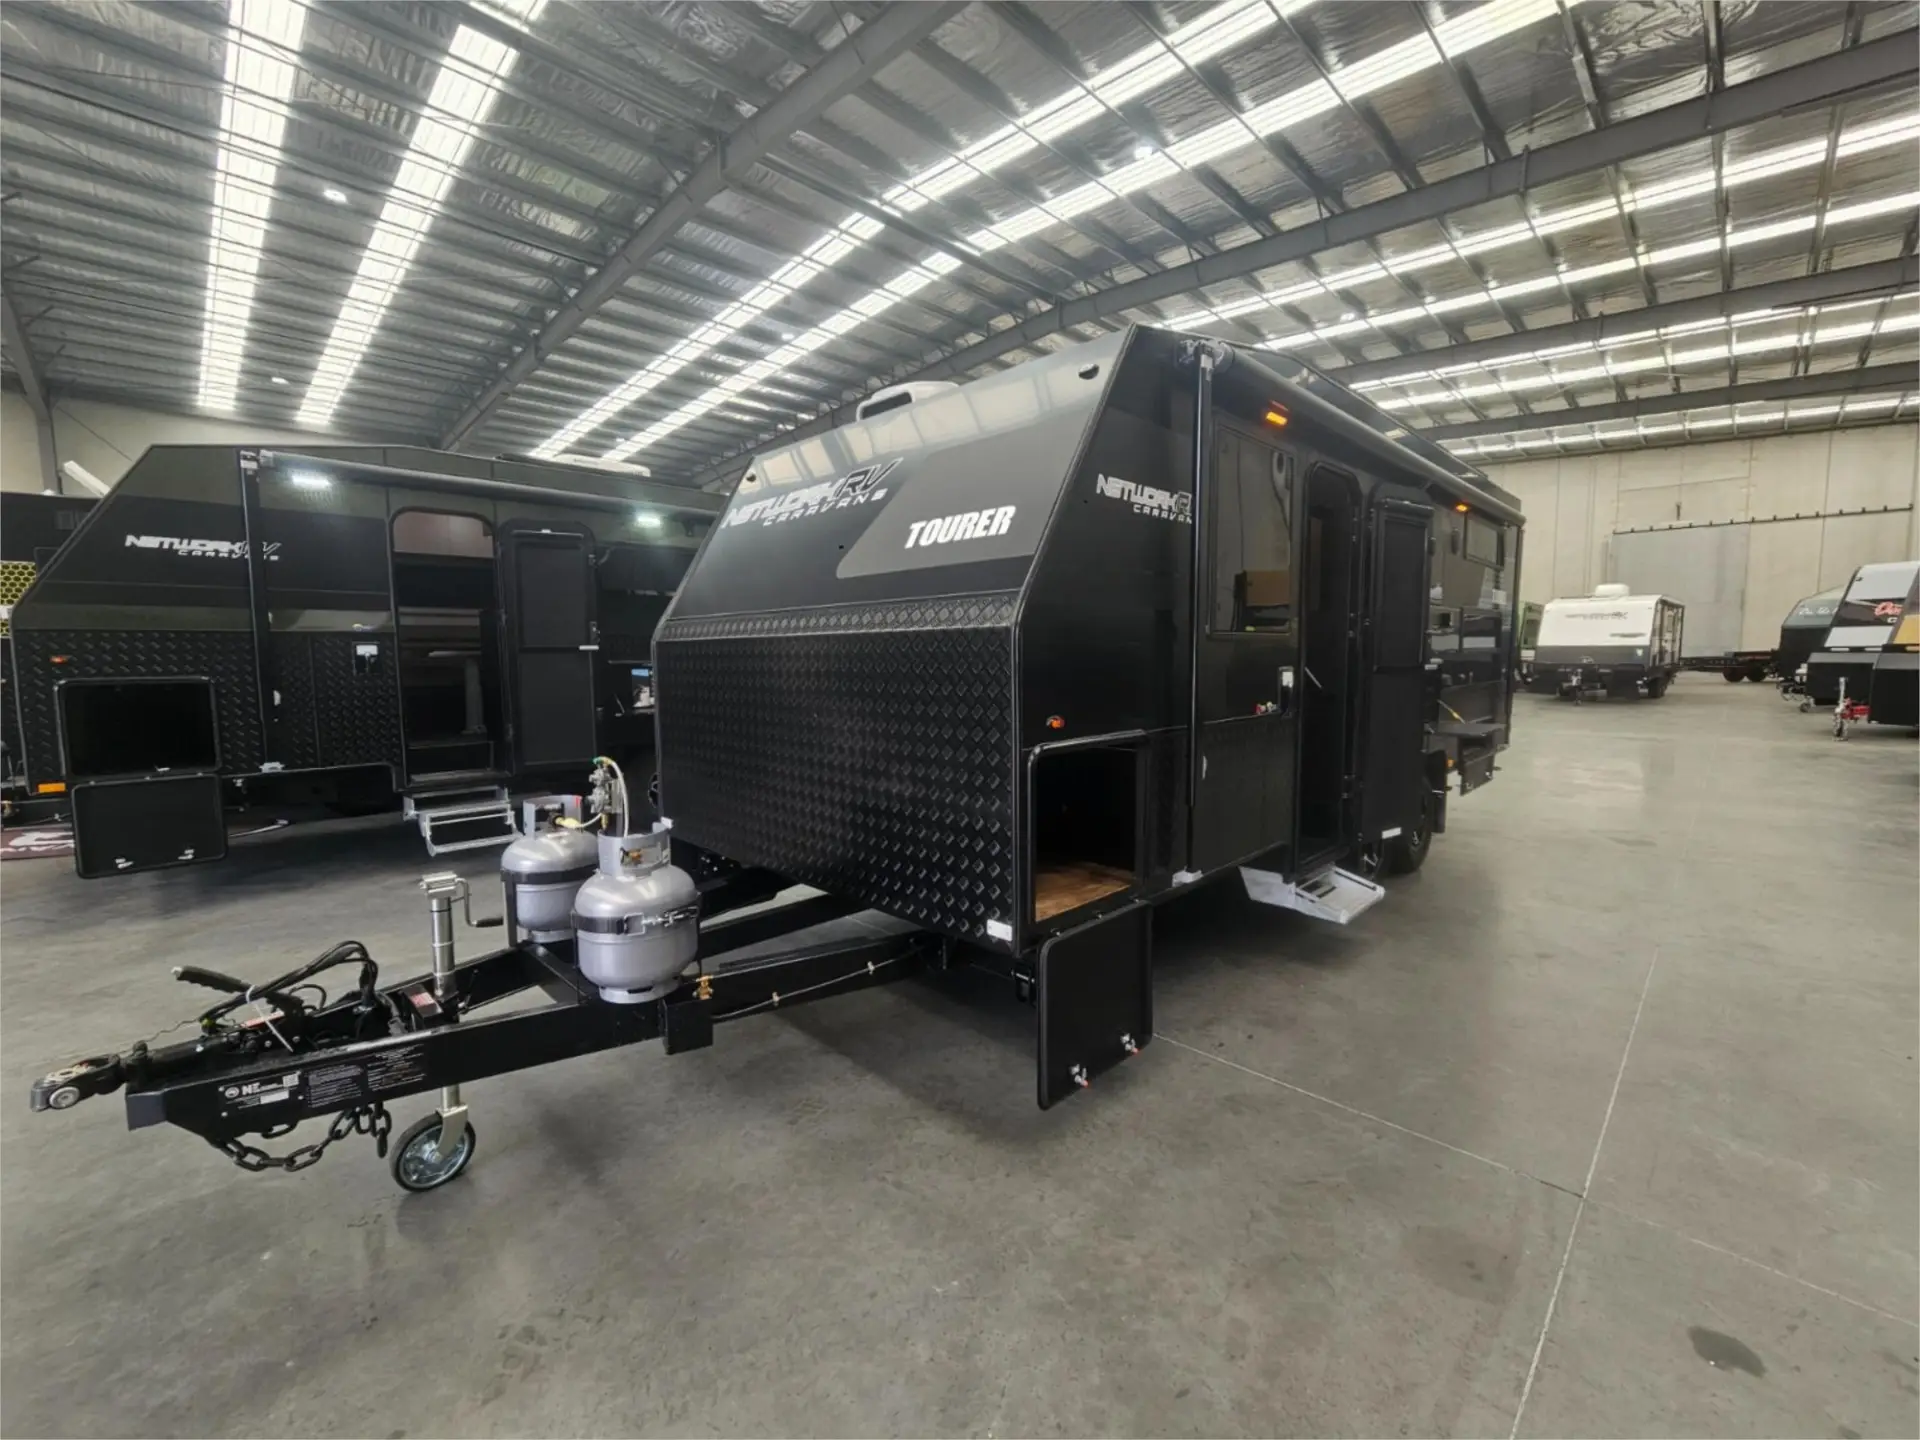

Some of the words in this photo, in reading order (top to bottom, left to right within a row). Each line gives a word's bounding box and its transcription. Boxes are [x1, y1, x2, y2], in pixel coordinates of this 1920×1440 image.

[763, 488, 888, 527] CARAVANS
[904, 505, 1016, 549] TOURER
[1133, 504, 1192, 524] CARAVAN
